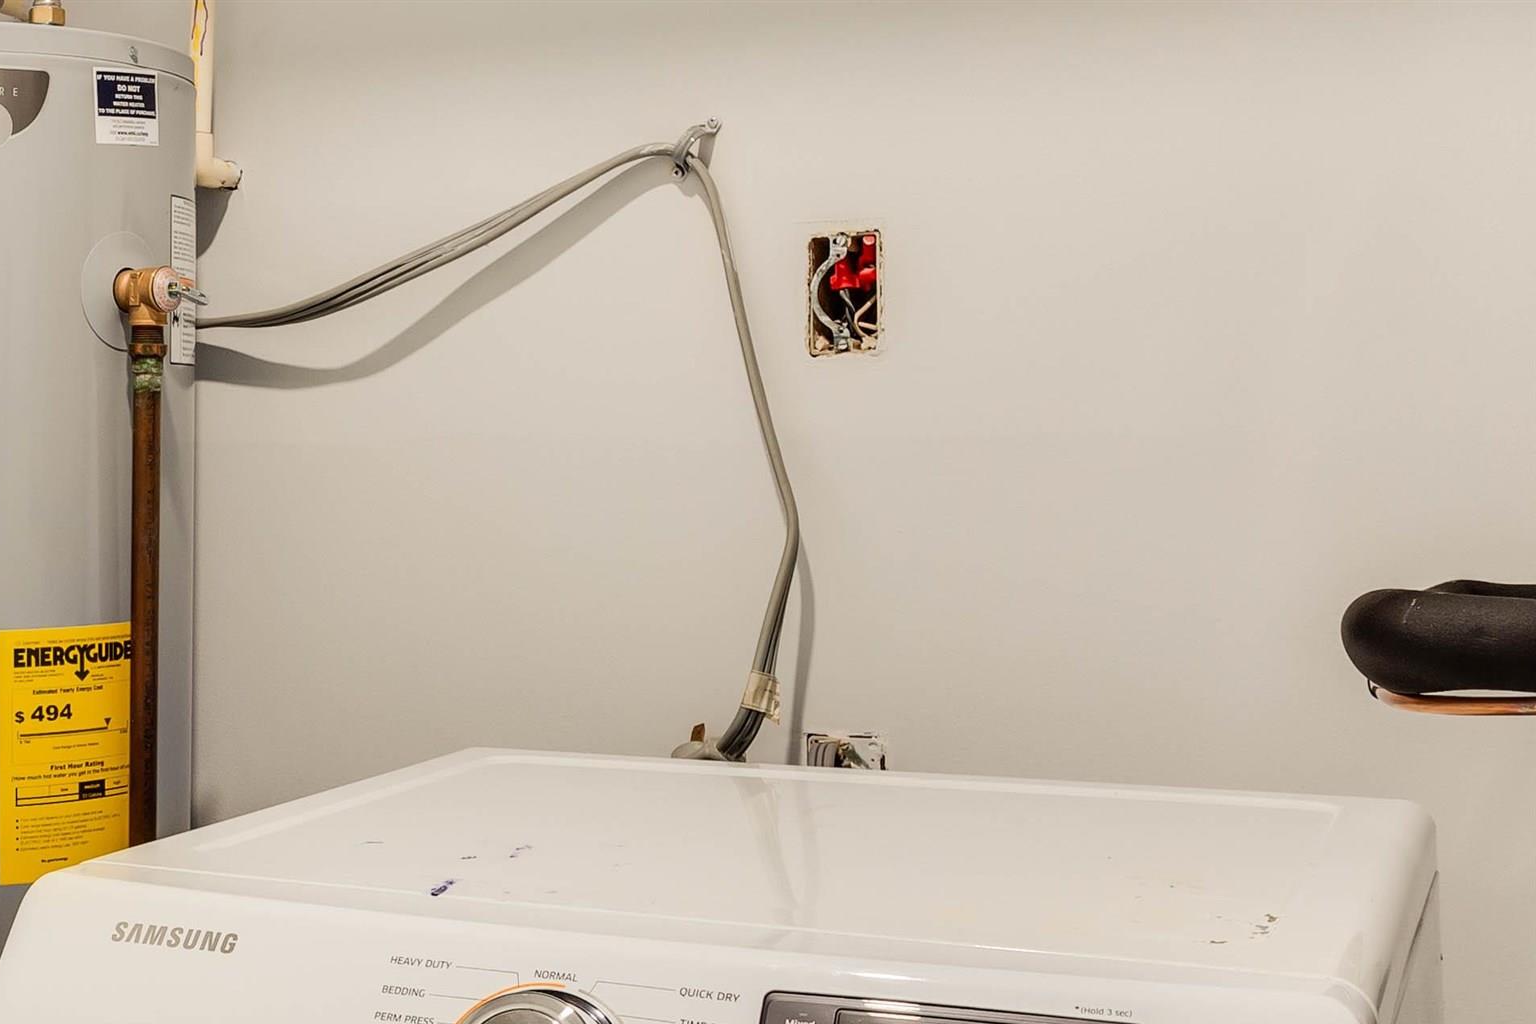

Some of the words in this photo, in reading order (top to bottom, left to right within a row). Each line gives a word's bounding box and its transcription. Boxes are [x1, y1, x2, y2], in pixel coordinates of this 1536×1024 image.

[14, 640, 131, 669] ENERGYGUIDE
[31, 704, 72, 721] 494
[112, 921, 238, 954] SAMSUNG
[390, 956, 422, 967] HEAVY
[425, 960, 452, 969] DUTY
[534, 970, 578, 982] NORMAL
[382, 985, 425, 998] BEDDING
[679, 988, 713, 1000] QUICK
[717, 992, 740, 1002] DRY
[375, 1011, 402, 1022] PERM
